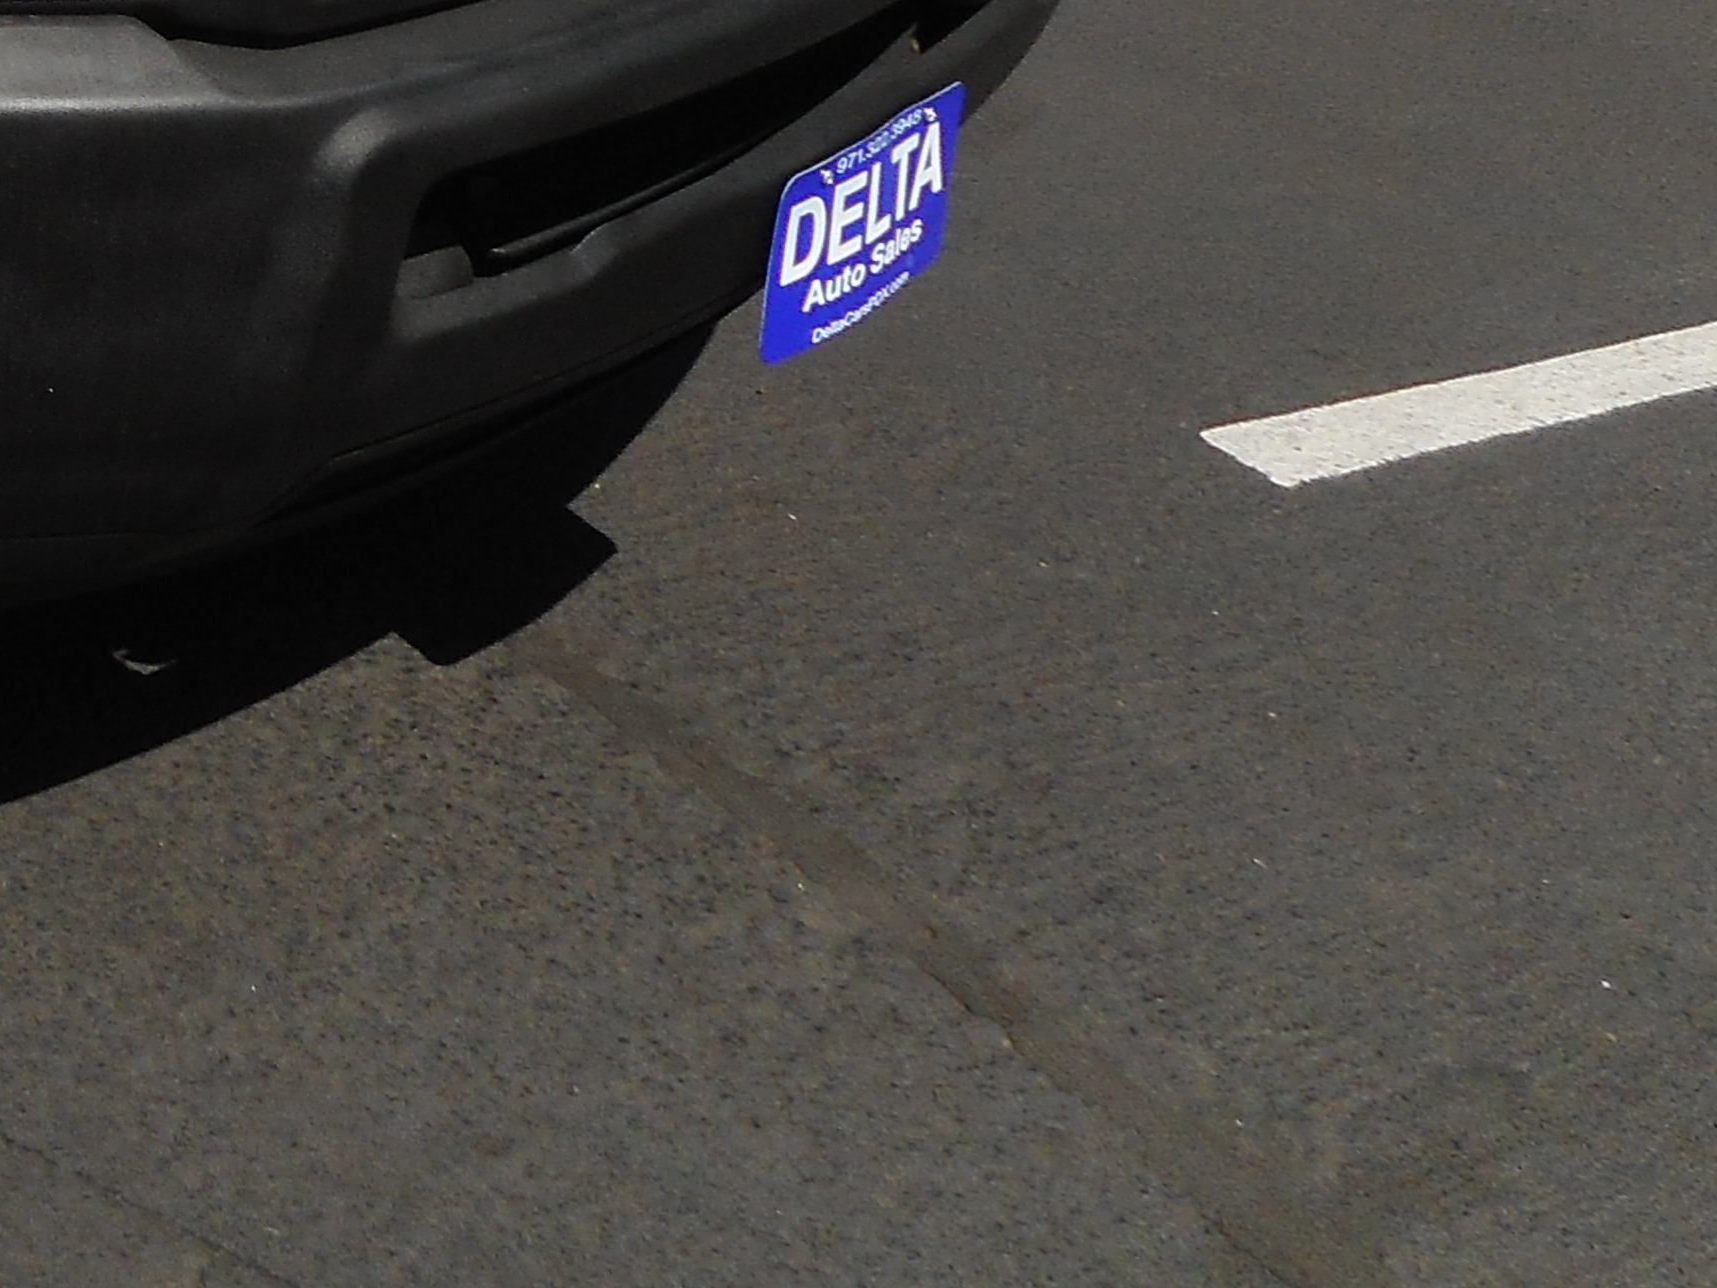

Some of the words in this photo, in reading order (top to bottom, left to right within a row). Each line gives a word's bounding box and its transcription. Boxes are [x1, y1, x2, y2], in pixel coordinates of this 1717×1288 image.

[780, 122, 943, 287] DELTA
[802, 263, 866, 313] Auto
[870, 219, 923, 274] Sales
